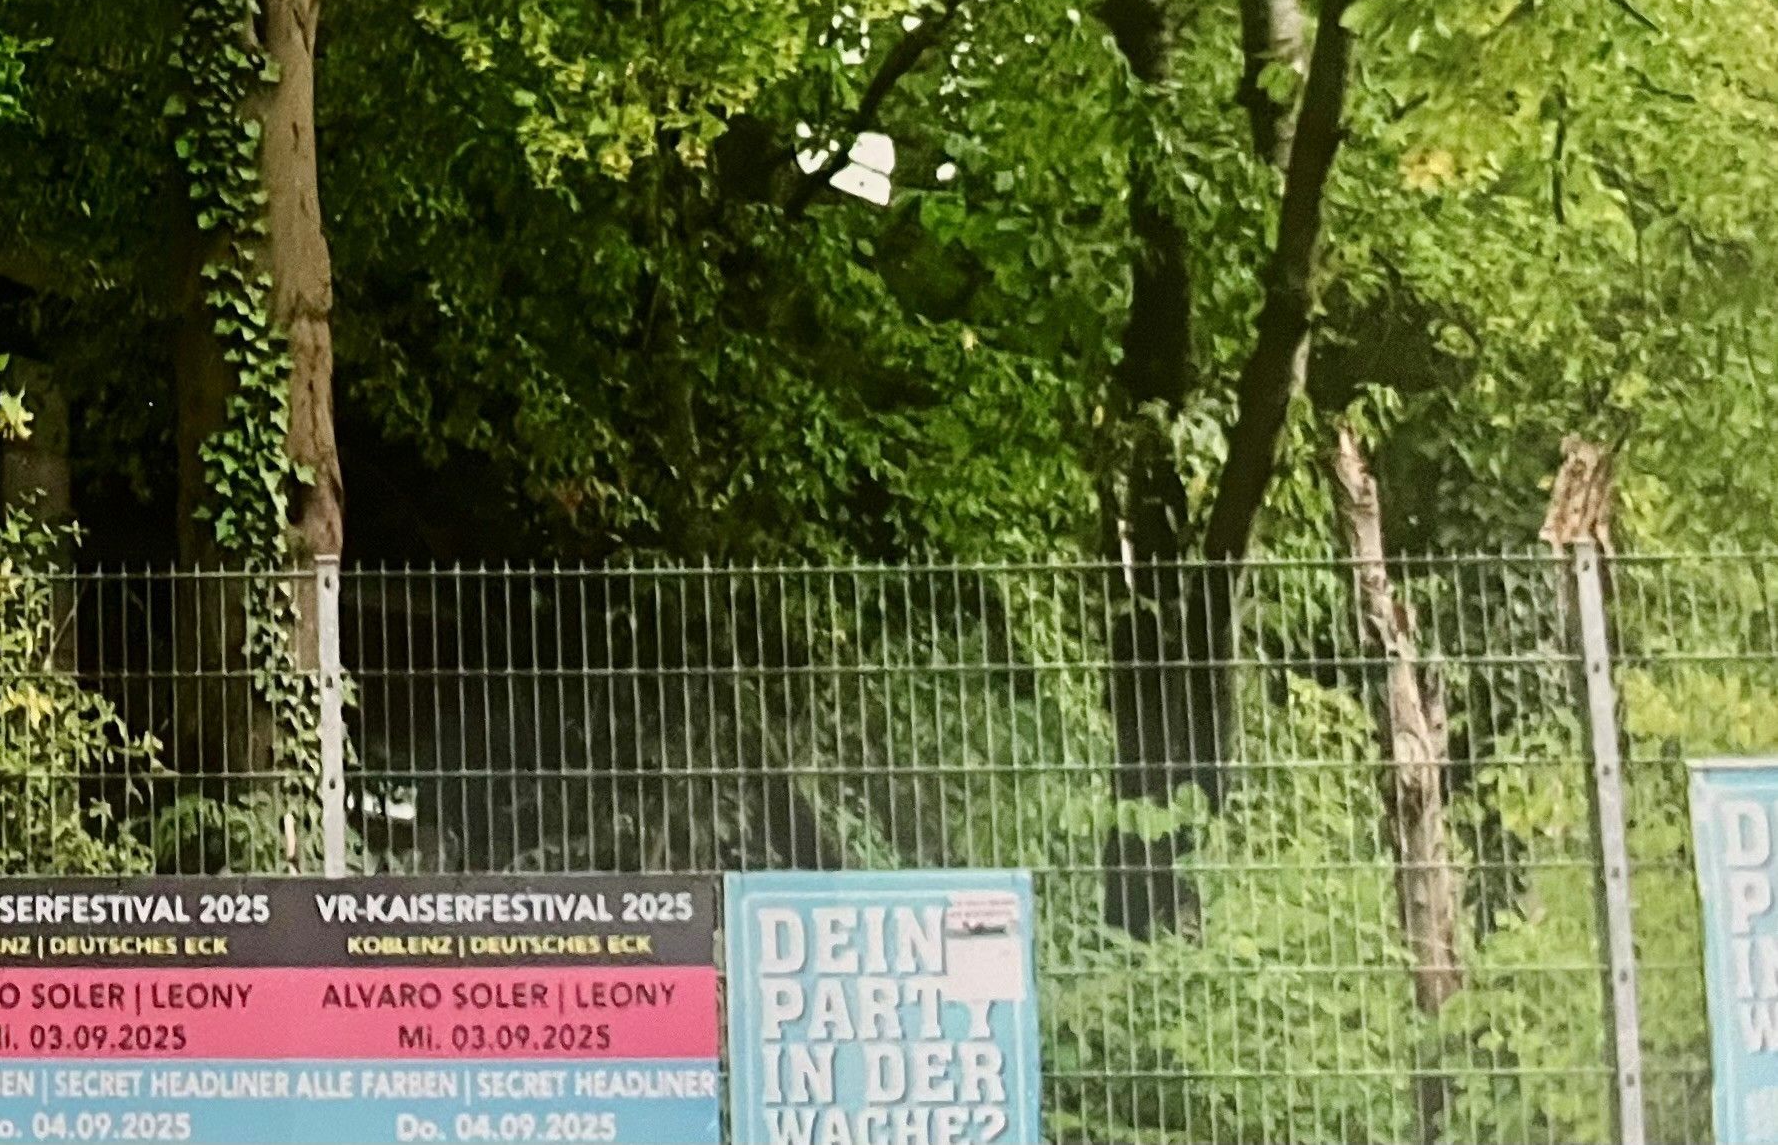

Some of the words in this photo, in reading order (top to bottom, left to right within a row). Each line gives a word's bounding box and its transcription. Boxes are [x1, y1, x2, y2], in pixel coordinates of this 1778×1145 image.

[199, 894, 271, 923] 2025
[315, 893, 613, 923] VR-KAISERFESTIVAL
[621, 892, 694, 922] 2025
[50, 936, 177, 955] DEUTSCHES
[185, 936, 228, 955] ECK
[347, 935, 453, 955] KOBLENZ
[470, 935, 600, 955] DEUTSCHES
[607, 935, 653, 955] ECK
[758, 907, 946, 974] DEIN
[31, 982, 124, 1009] SOLER
[152, 982, 254, 1009] LEONY
[322, 982, 442, 1009] ALVARO
[452, 982, 549, 1009] SOLER
[575, 981, 676, 1008] LEONY
[30, 1024, 187, 1051] 03.09.2025
[398, 1024, 442, 1051] Mi.
[452, 1024, 611, 1051] 03.09.2025
[55, 1069, 141, 1098] SECRET
[151, 1069, 290, 1098] HEADLINER
[296, 1069, 353, 1099] ALLE
[361, 1069, 457, 1098] FARBEN
[477, 1069, 567, 1099] SECRET
[575, 1069, 715, 1099] HEADLINER
[762, 1042, 836, 1104] IN
[865, 1041, 1007, 1104] DER
[33, 1112, 192, 1140] 04.09.2025
[395, 1112, 446, 1141] Do.
[455, 1112, 617, 1141] 04.09.2025
